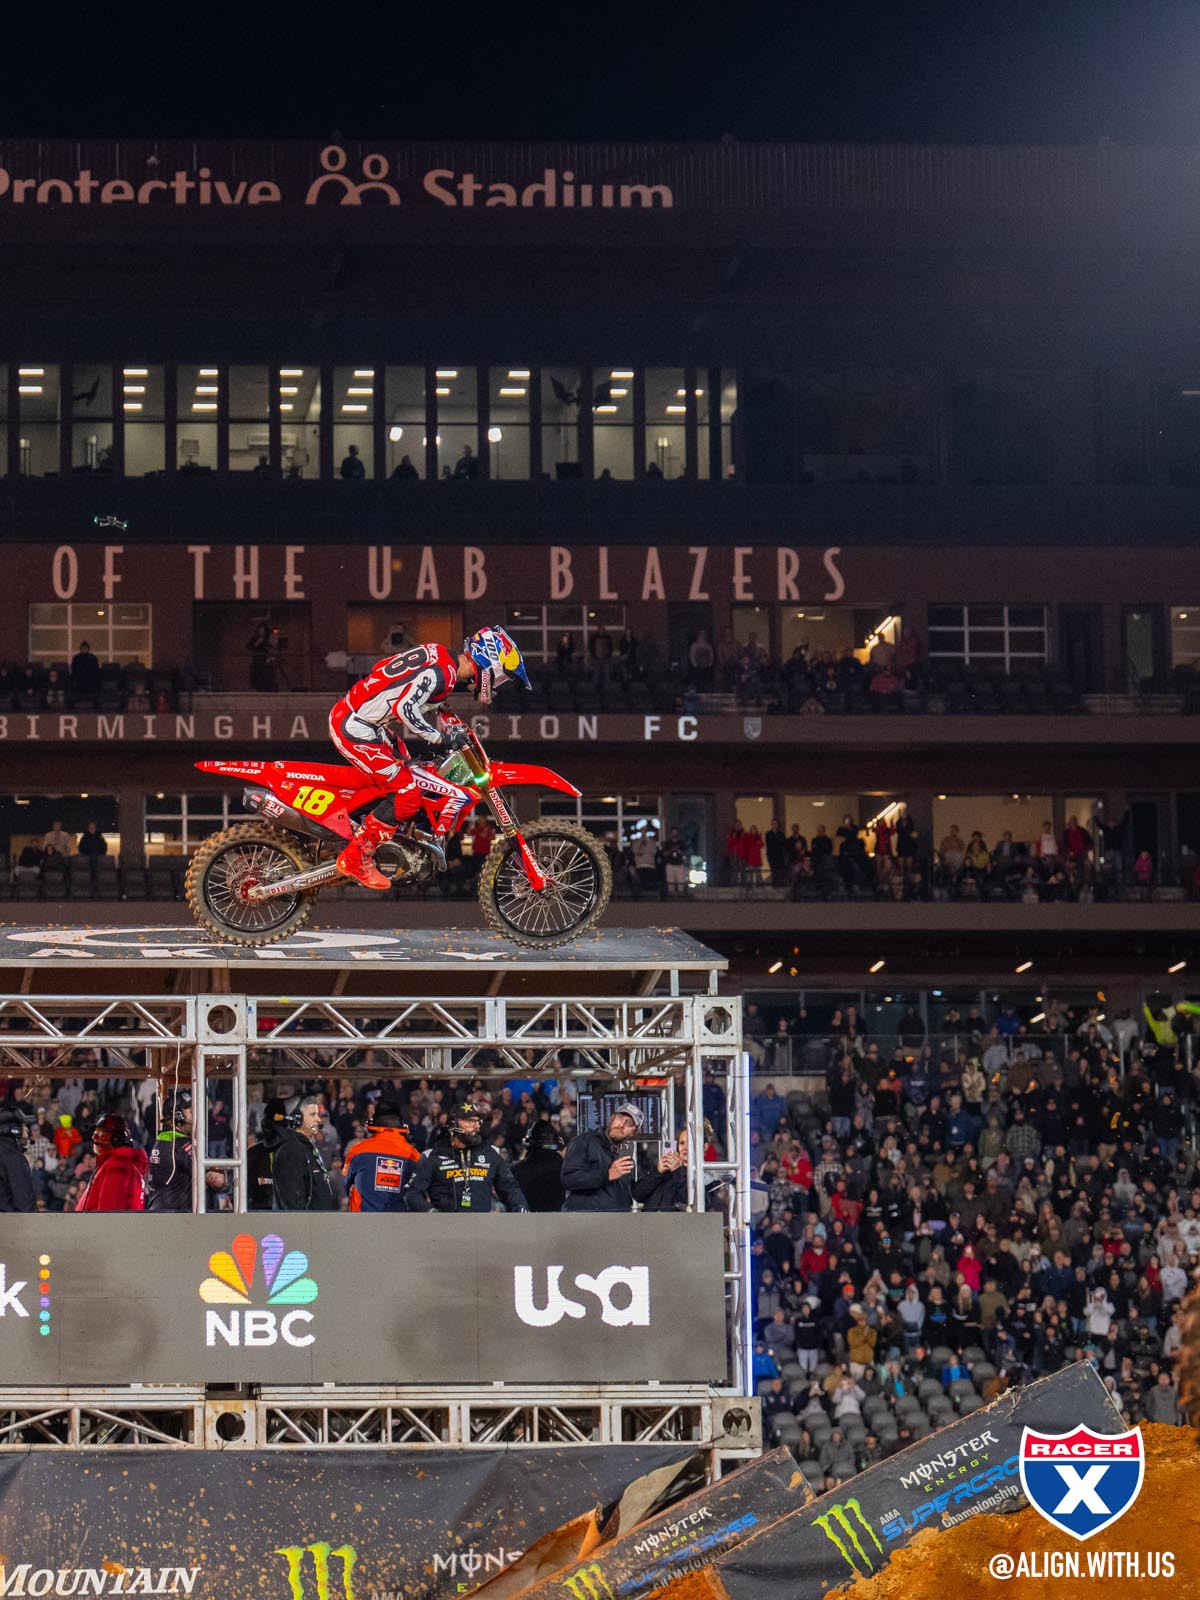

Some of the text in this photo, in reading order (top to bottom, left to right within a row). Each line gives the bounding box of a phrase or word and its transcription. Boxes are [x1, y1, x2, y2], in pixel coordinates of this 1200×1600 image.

[422, 168, 674, 208] Stadium
[52, 545, 124, 600] OF
[187, 545, 305, 600] THE
[368, 545, 487, 600] UAB
[550, 546, 845, 601] BLAZERS
[644, 715, 698, 740] FC
[218, 766, 262, 774] DUNLOP
[286, 771, 326, 782] HONDA
[292, 785, 335, 816] 18
[446, 1167, 488, 1179] ROCSTAR
[206, 1310, 315, 1347] NBC
[899, 1430, 1000, 1490] MONSTER
[924, 1453, 990, 1493] ENERGY
[879, 1508, 901, 1526] AMA
[882, 1454, 1020, 1542] SUPERCRO
[940, 1483, 1020, 1531] Championship
[633, 1506, 713, 1555] MONSTER
